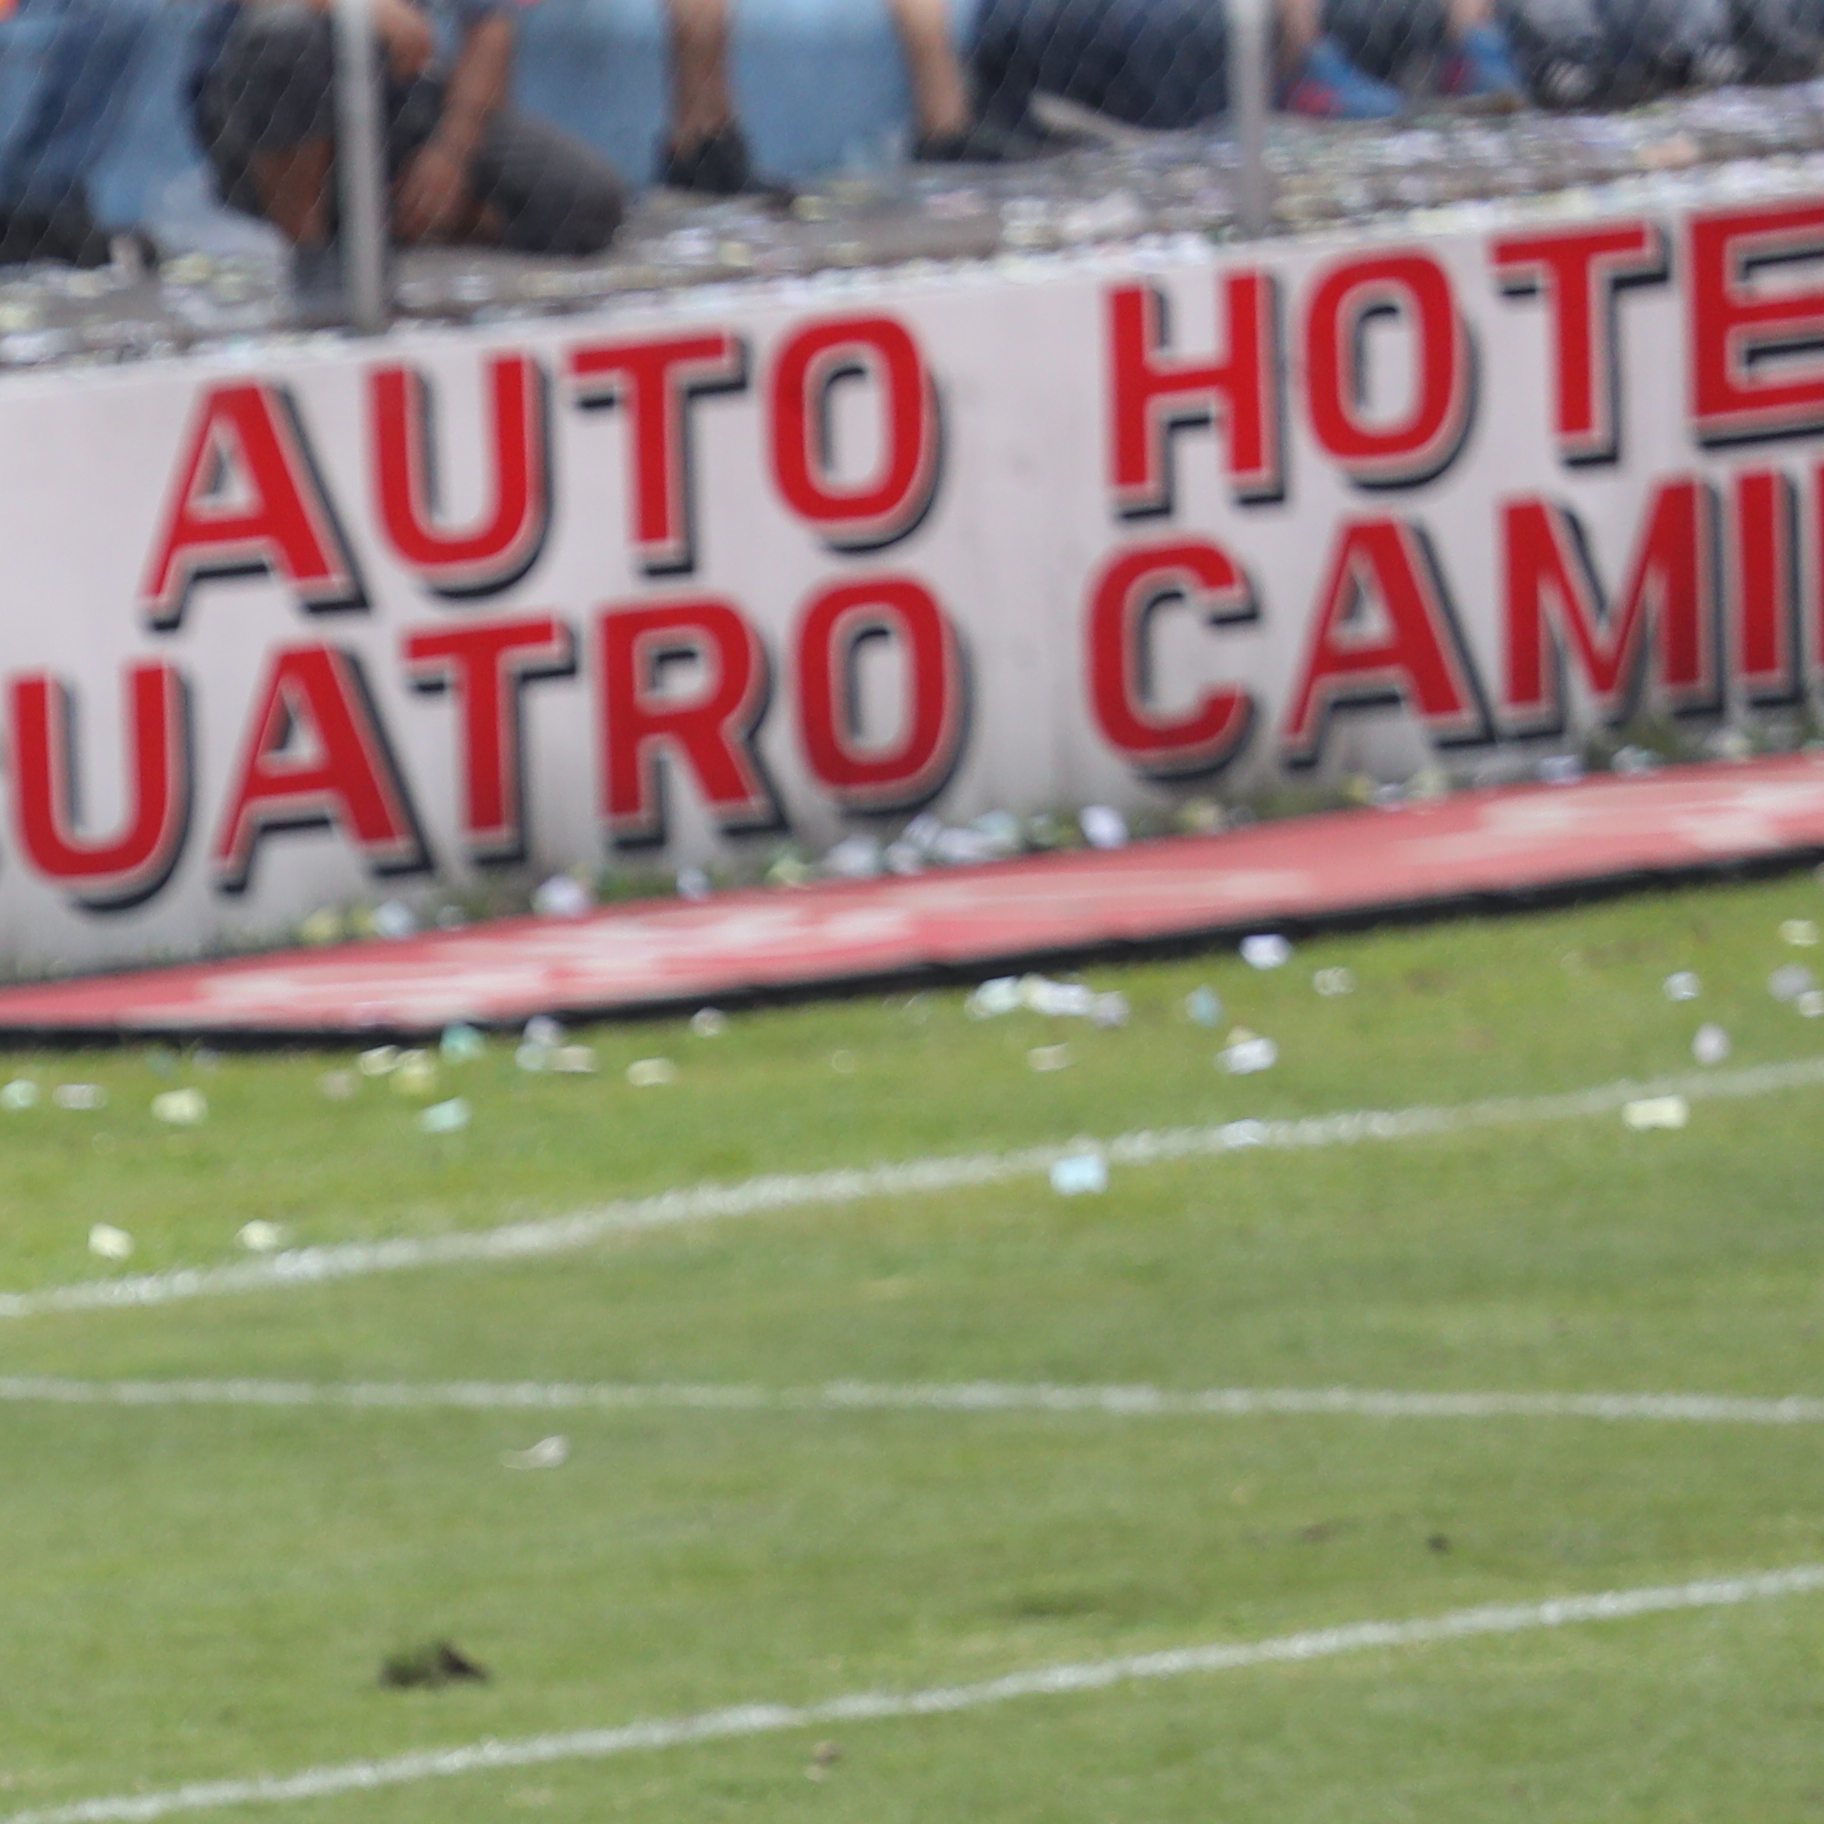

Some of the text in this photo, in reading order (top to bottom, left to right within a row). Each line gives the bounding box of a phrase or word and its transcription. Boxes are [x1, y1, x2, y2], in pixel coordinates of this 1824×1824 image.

[135, 196, 1824, 632] AUTO HOTE
[1084, 462, 1824, 786] CAMI
